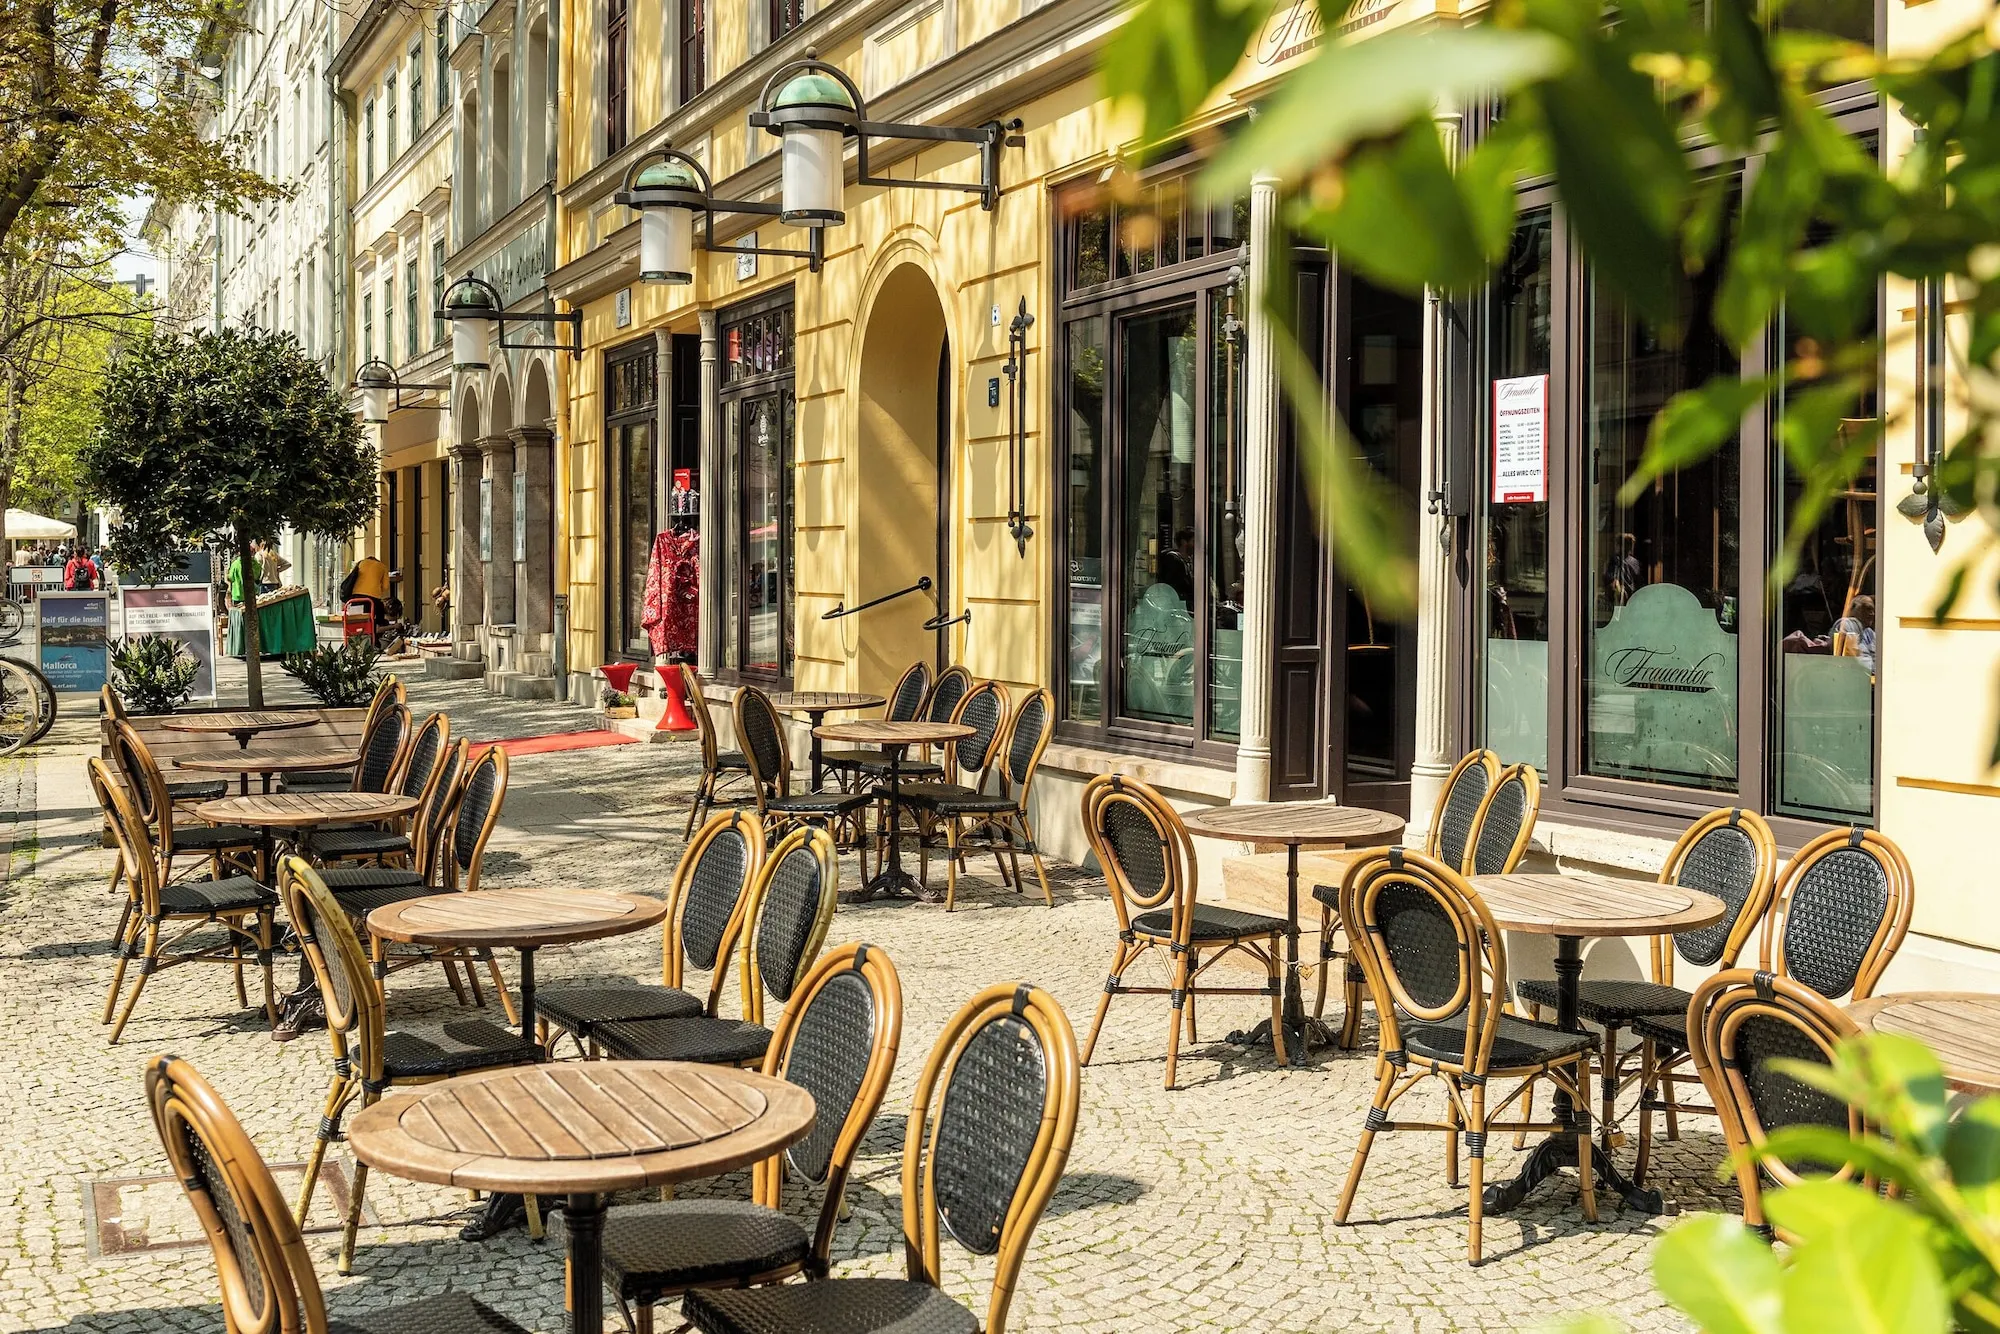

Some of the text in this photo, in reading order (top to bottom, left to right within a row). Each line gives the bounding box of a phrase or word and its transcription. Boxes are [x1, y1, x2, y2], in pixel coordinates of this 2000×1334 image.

[1500, 407, 1540, 417] ÖFFNUNGSZEITEN
[41, 616, 56, 624] Reif
[42, 662, 77, 670] Mallorca
[1604, 645, 1726, 685] Frauentor
